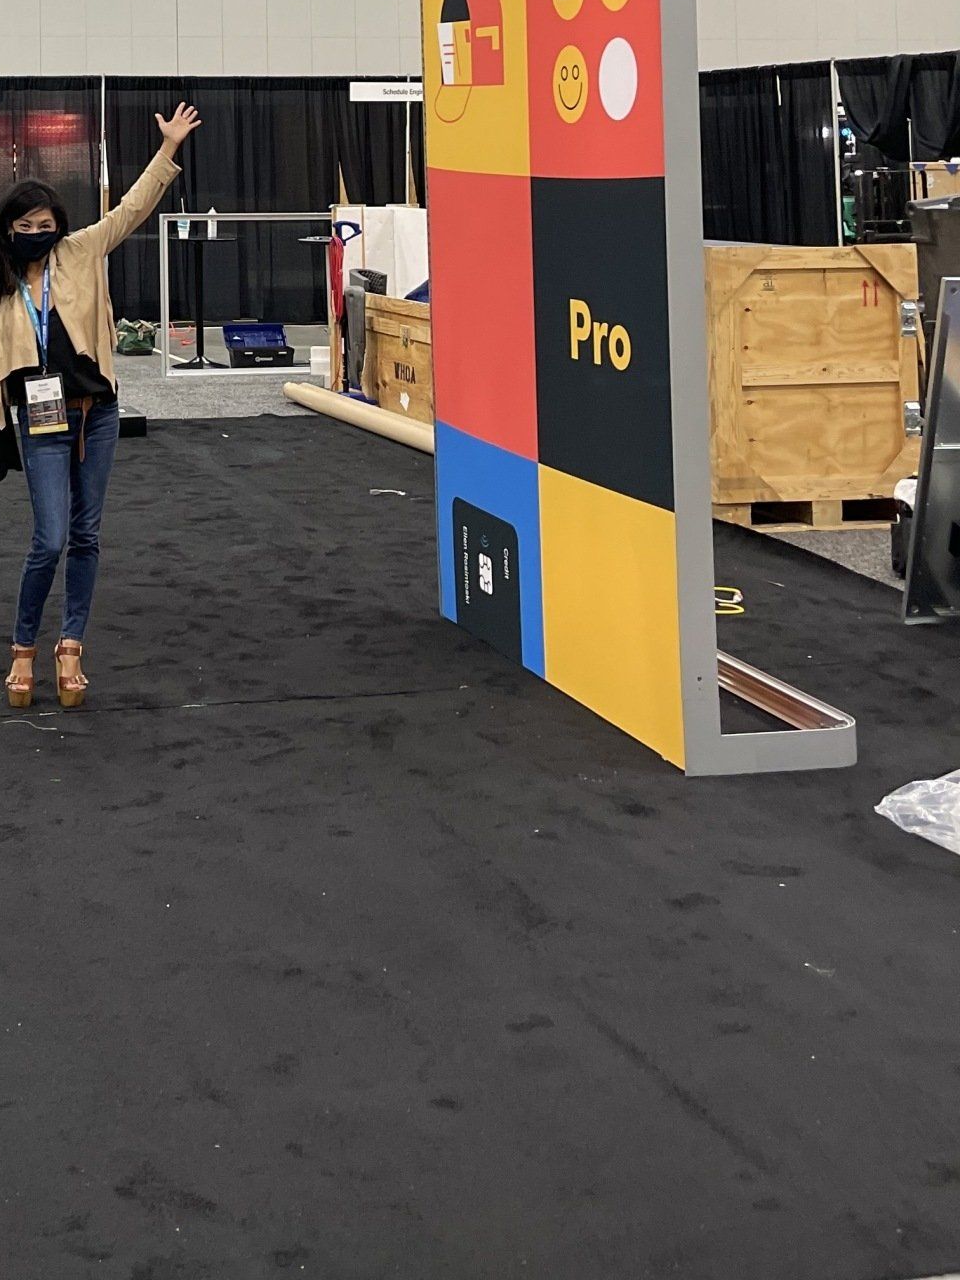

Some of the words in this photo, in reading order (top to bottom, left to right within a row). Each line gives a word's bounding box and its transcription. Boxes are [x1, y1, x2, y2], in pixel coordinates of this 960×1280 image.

[382, 88, 408, 96] Schedule
[569, 298, 632, 371] Pro
[393, 361, 416, 385] WHOA
